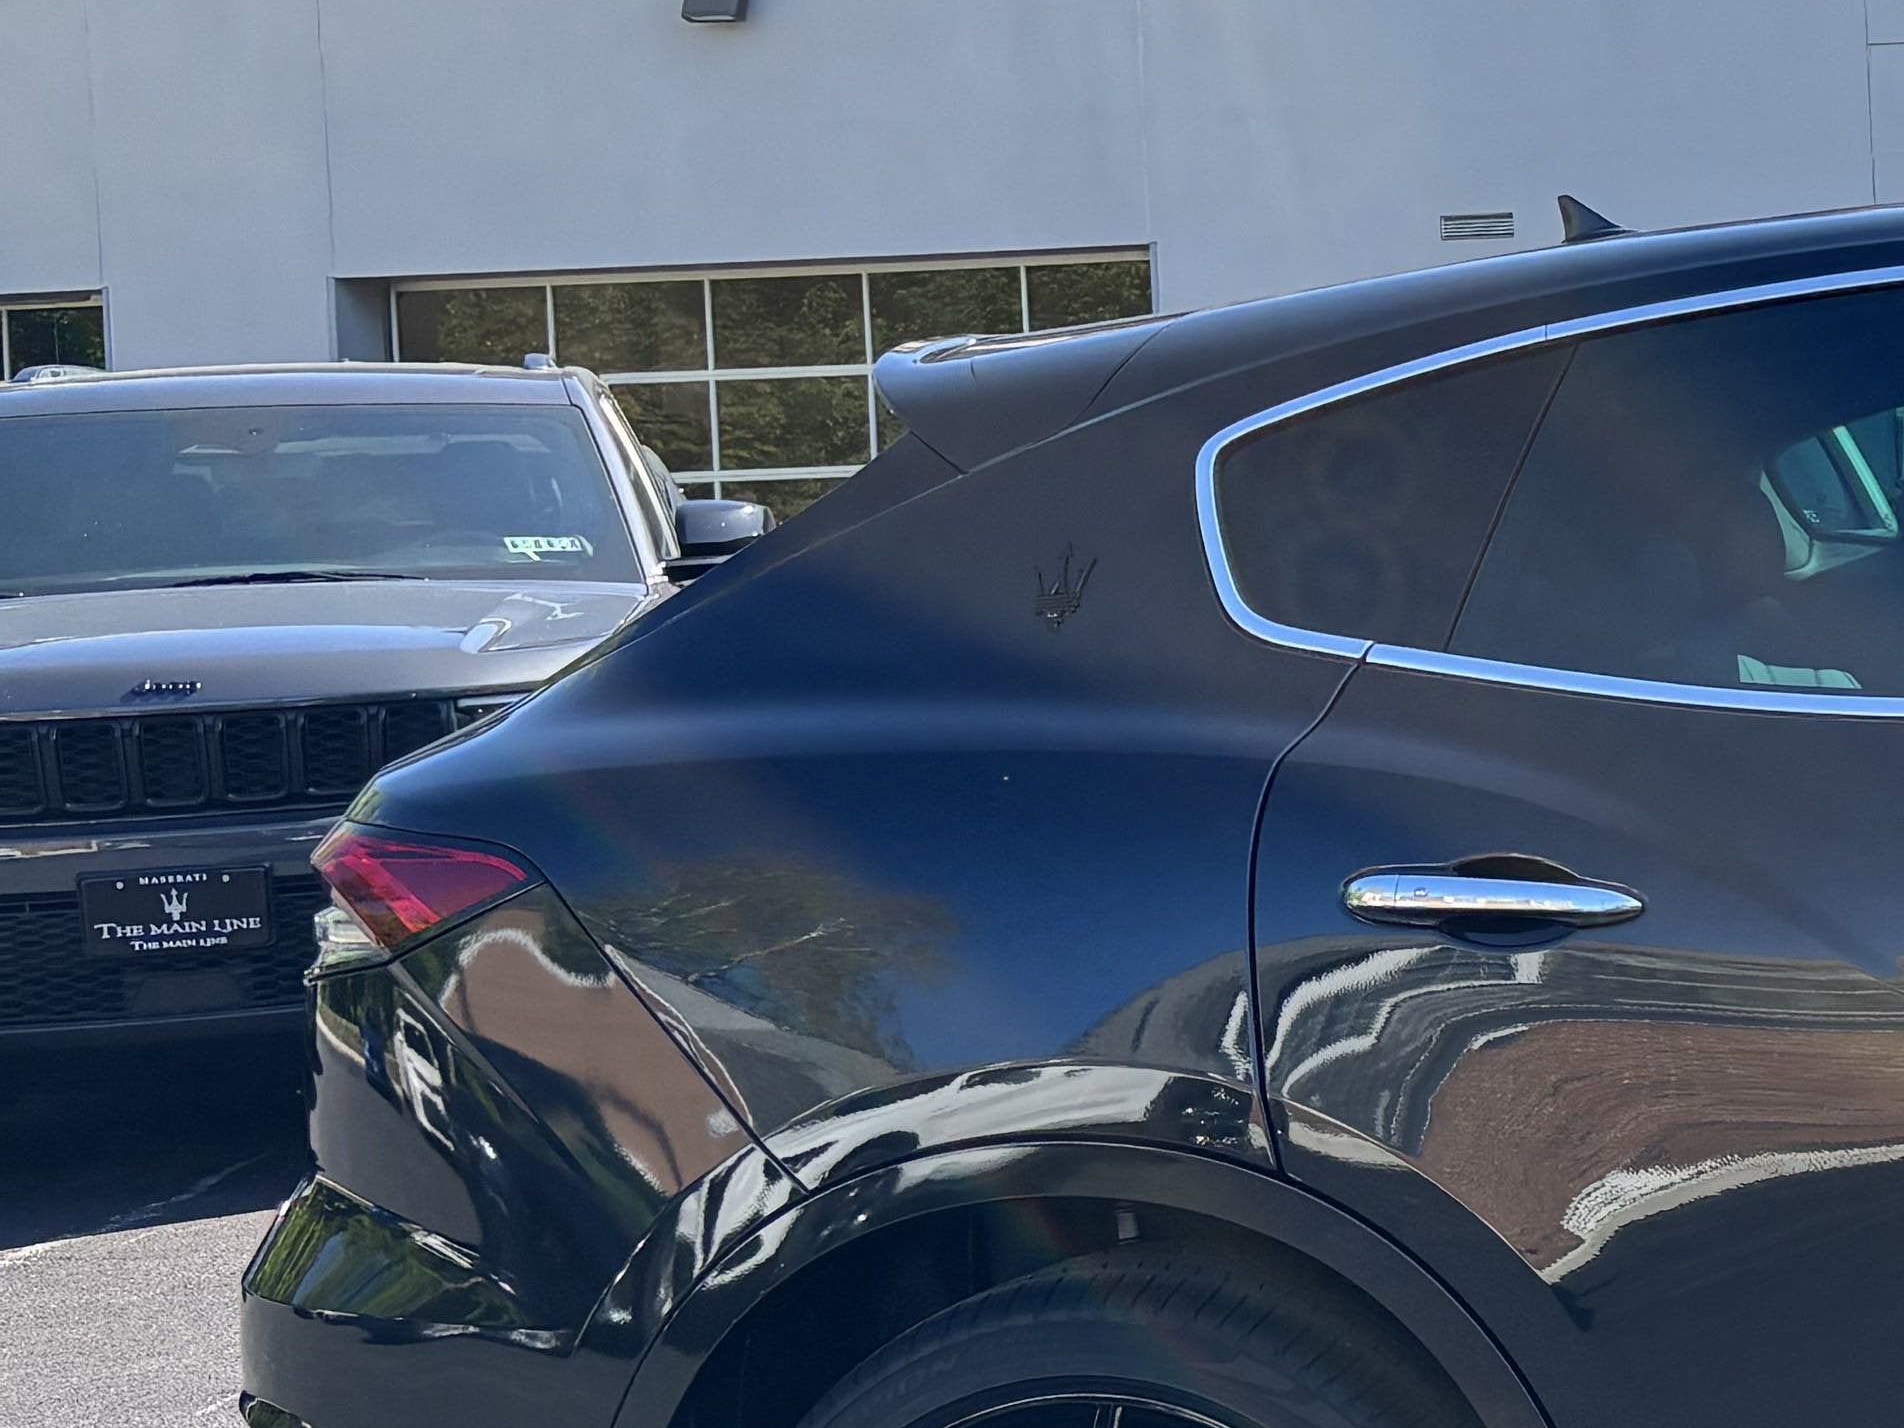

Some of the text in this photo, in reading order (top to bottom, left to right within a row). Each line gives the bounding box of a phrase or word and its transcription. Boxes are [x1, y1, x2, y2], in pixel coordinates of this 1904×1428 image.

[138, 873, 208, 885] MASERATI
[93, 917, 262, 940] THE MAIN LINE
[129, 936, 228, 951] THE MAIN LINE
